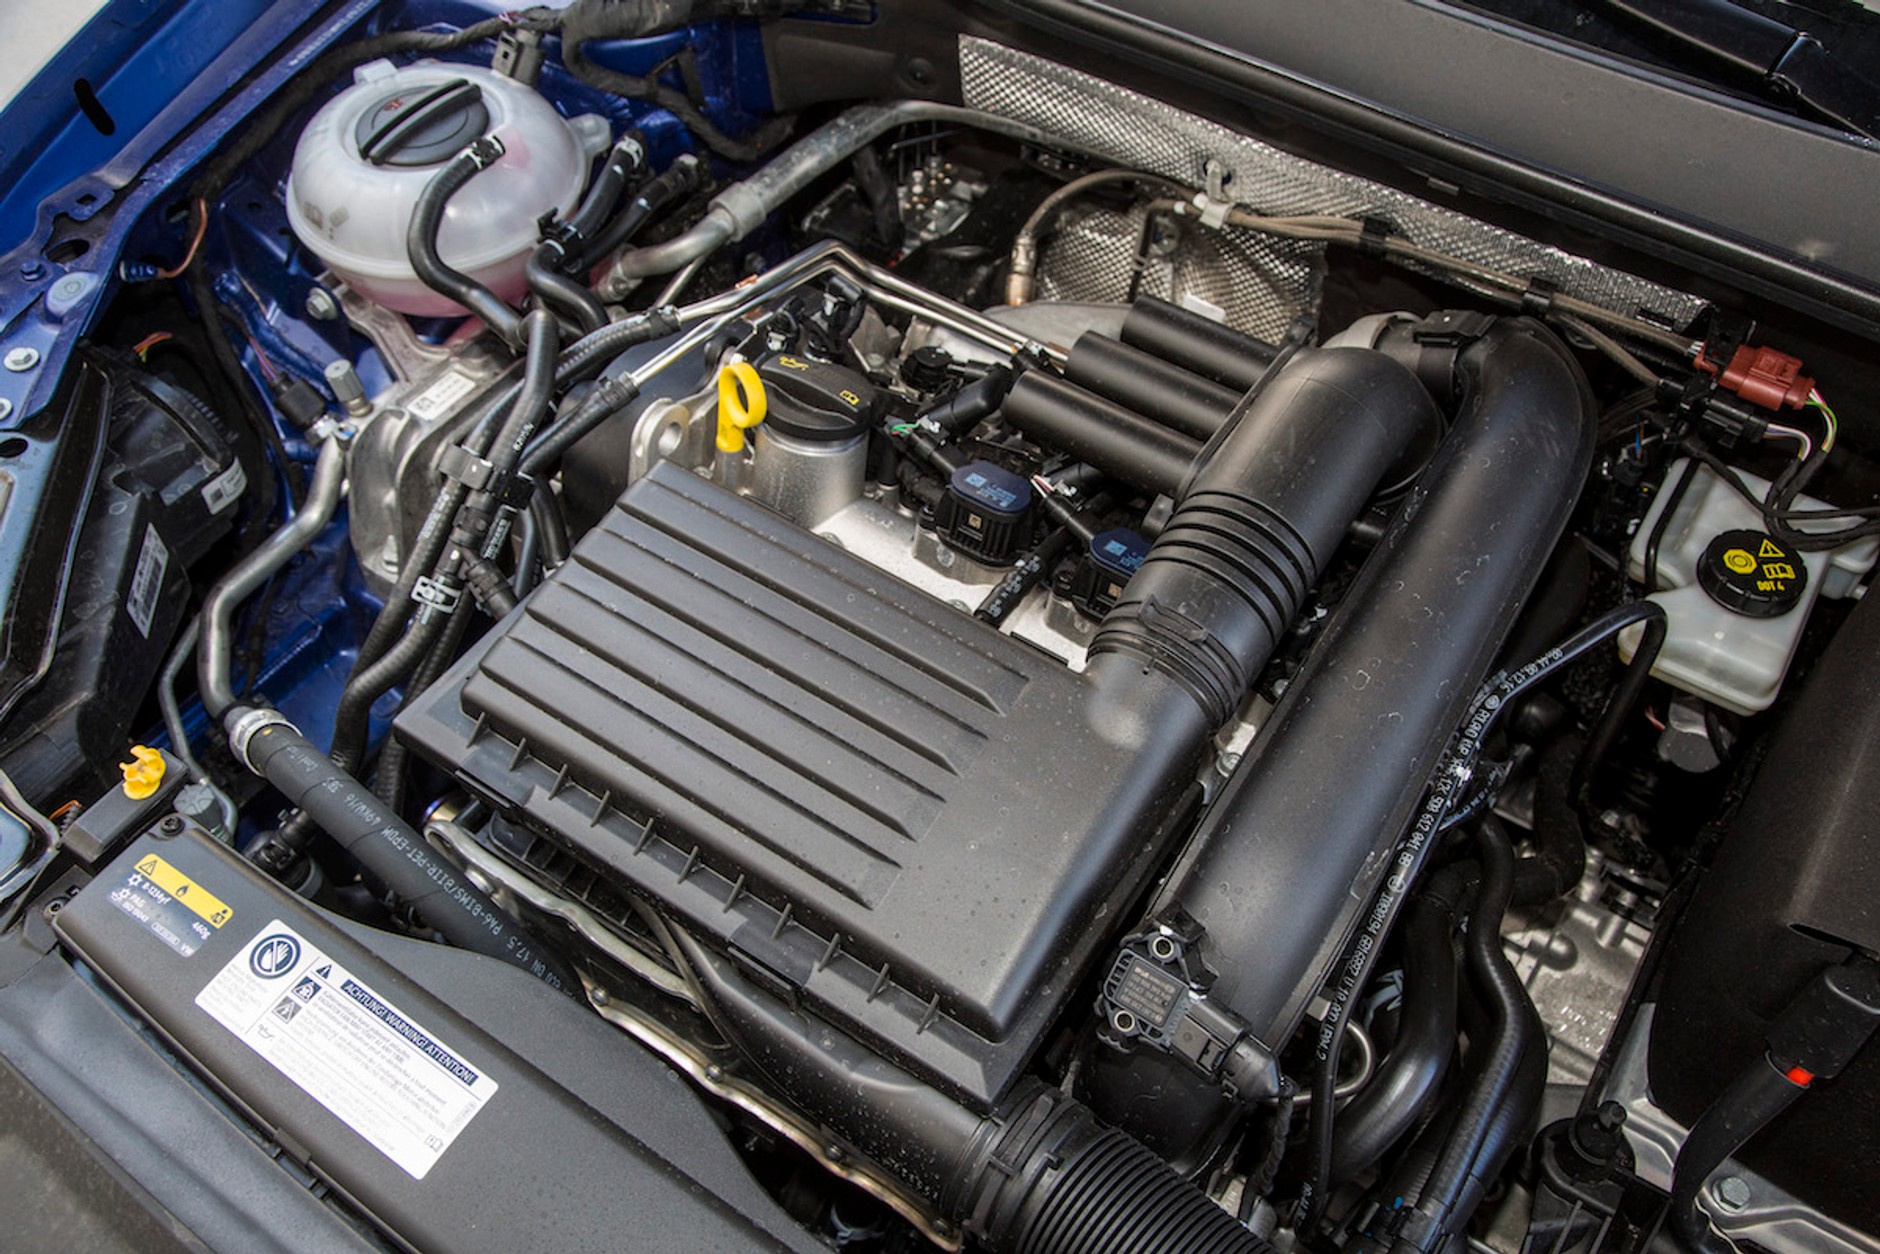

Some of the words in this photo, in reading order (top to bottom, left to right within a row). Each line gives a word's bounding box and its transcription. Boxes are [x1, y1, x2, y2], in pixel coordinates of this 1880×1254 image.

[343, 980, 388, 1019] ACHTUNG!
[383, 1010, 429, 1049] WARNING!
[424, 1041, 475, 1084] ATTENTION!
